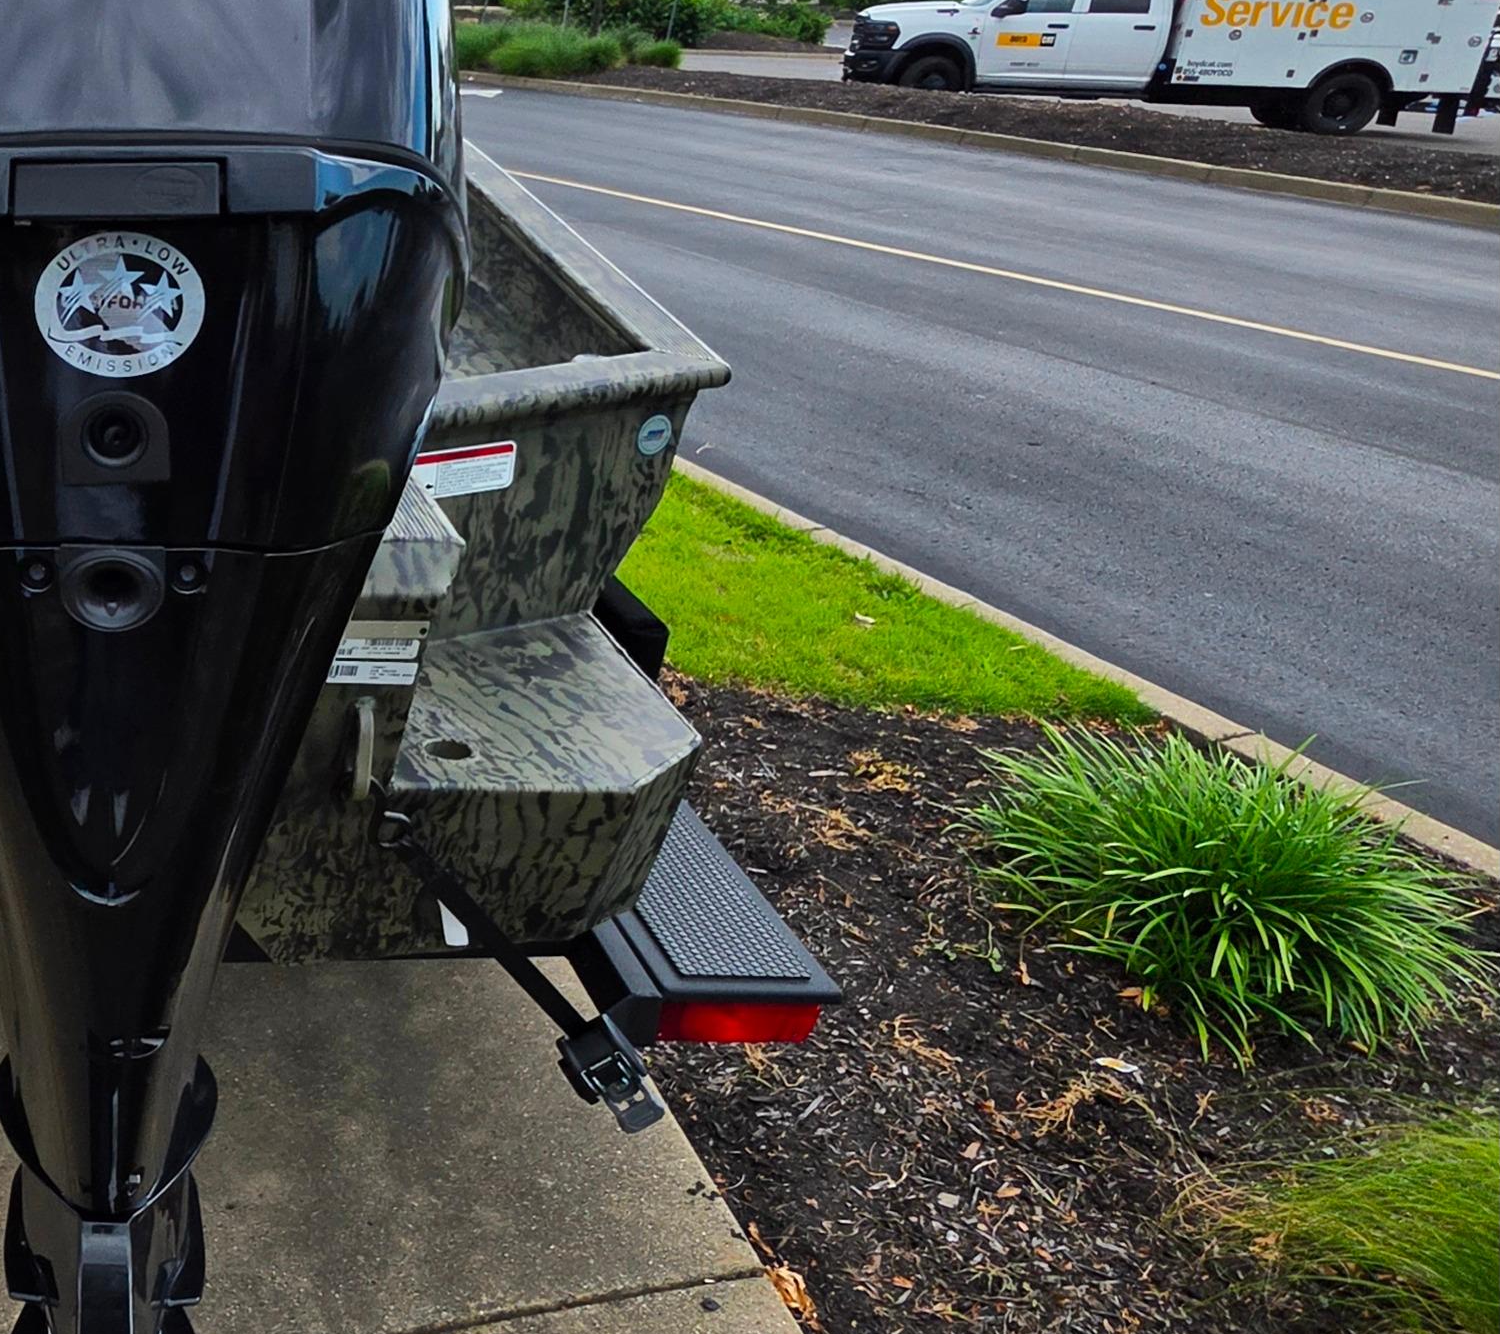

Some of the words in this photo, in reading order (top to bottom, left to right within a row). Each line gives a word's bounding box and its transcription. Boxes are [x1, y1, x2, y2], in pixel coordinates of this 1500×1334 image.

[56, 235, 125, 272] ULTRA
[144, 240, 190, 276] LOW
[64, 344, 176, 373] EMISSION
